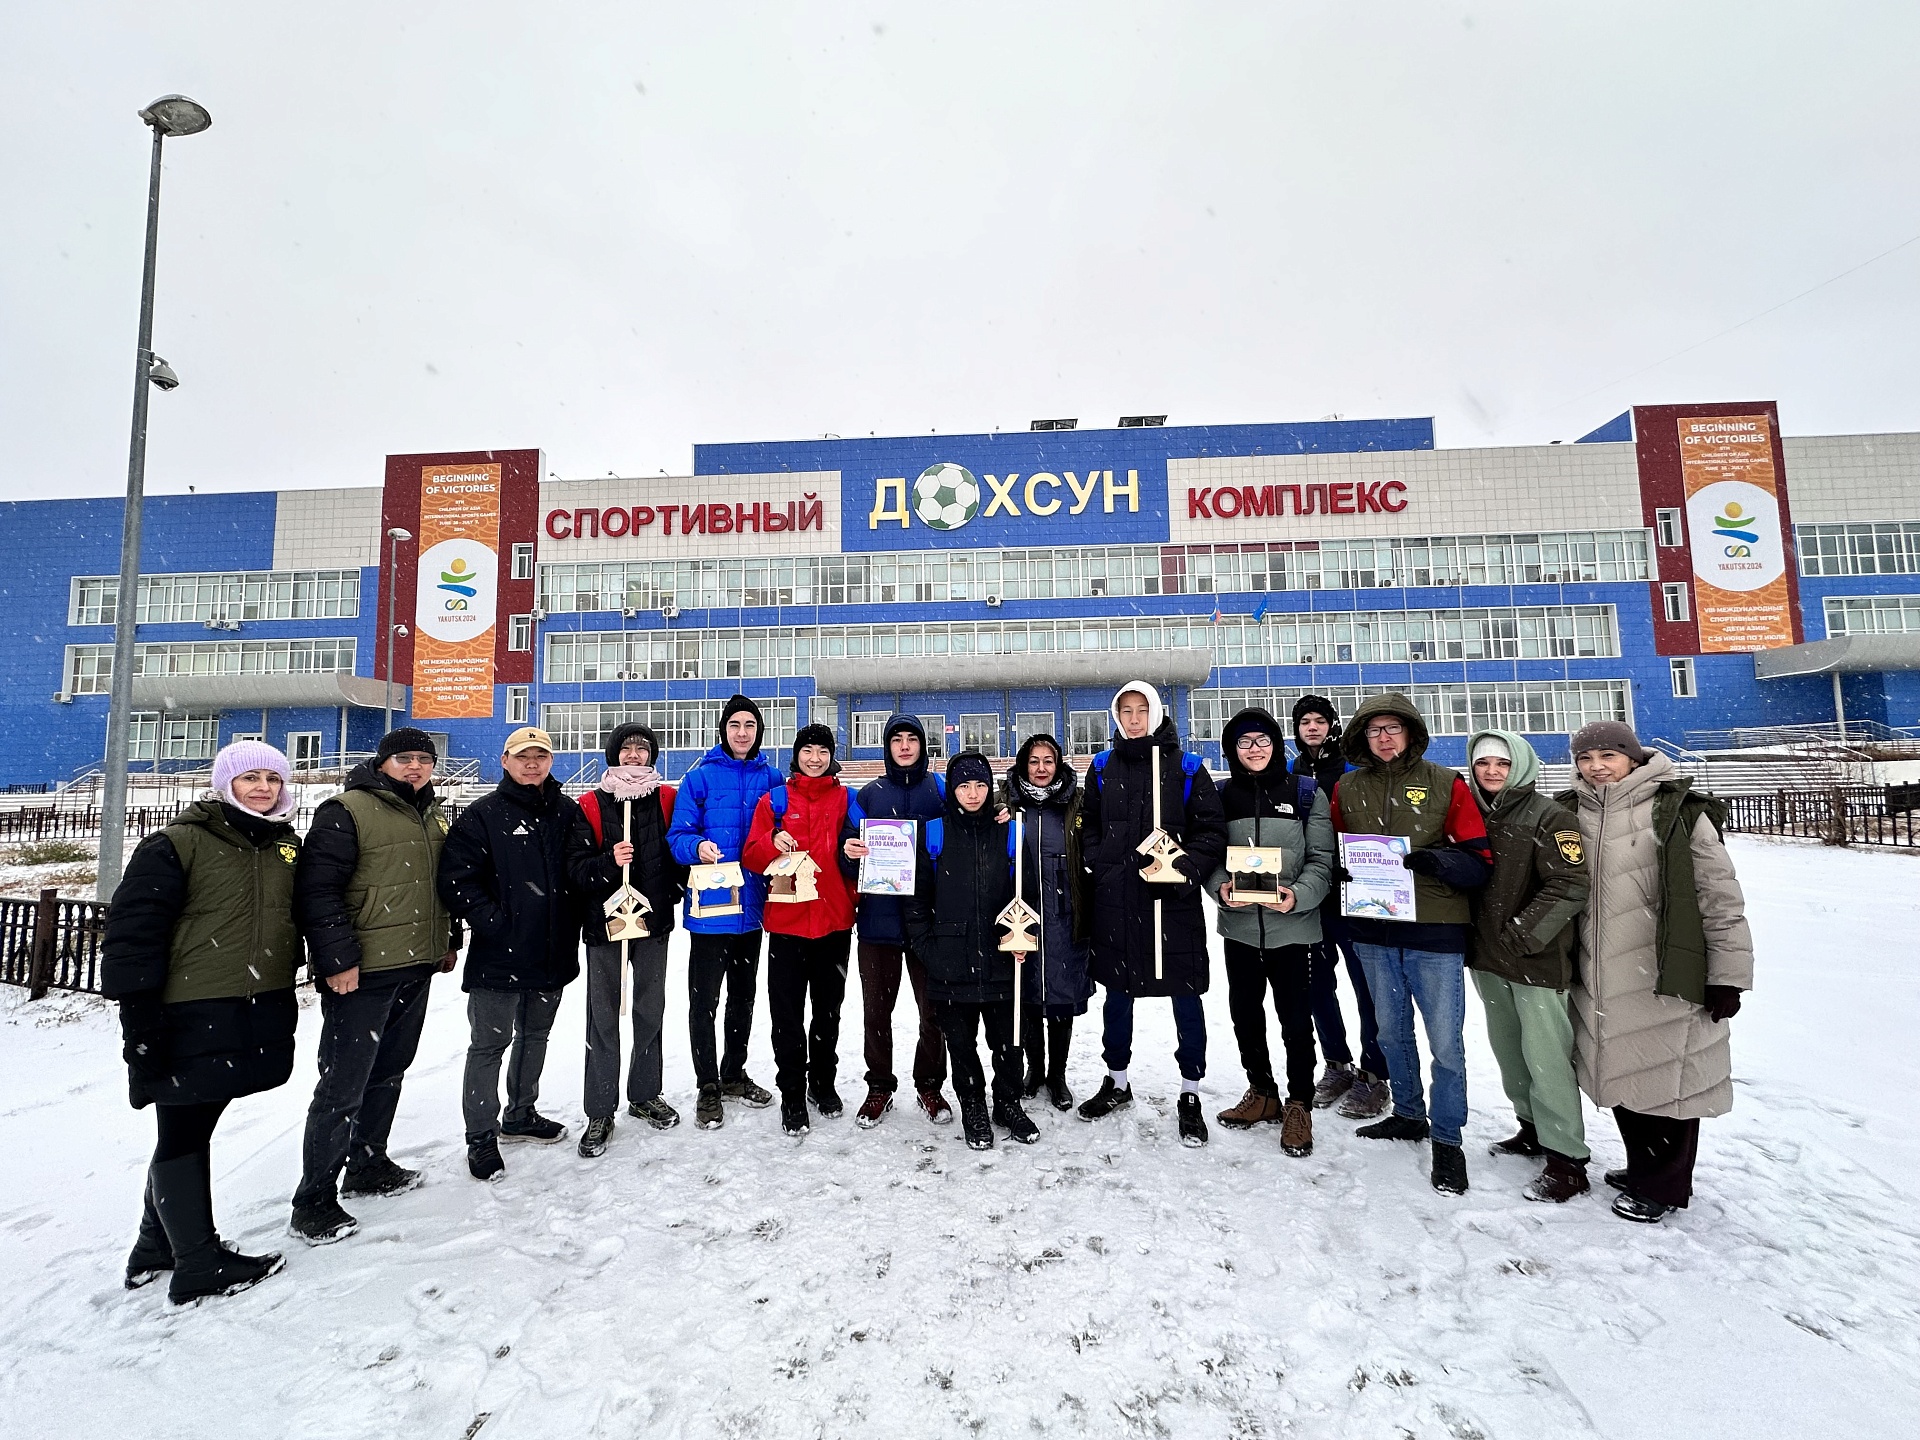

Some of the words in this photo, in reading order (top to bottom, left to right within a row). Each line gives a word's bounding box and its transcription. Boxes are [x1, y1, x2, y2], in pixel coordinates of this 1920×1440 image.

[1691, 423, 1756, 432] BEGINNING
[1685, 436, 1700, 444] OF
[1704, 434, 1764, 444] VICTORIES
[432, 474, 489, 482] BEGINNING
[426, 486, 440, 494] OF
[442, 484, 495, 494] VICTORIES
[1188, 480, 1408, 518] КОМПЛЕКС
[545, 492, 823, 539] СПОРТИВНЫЙ
